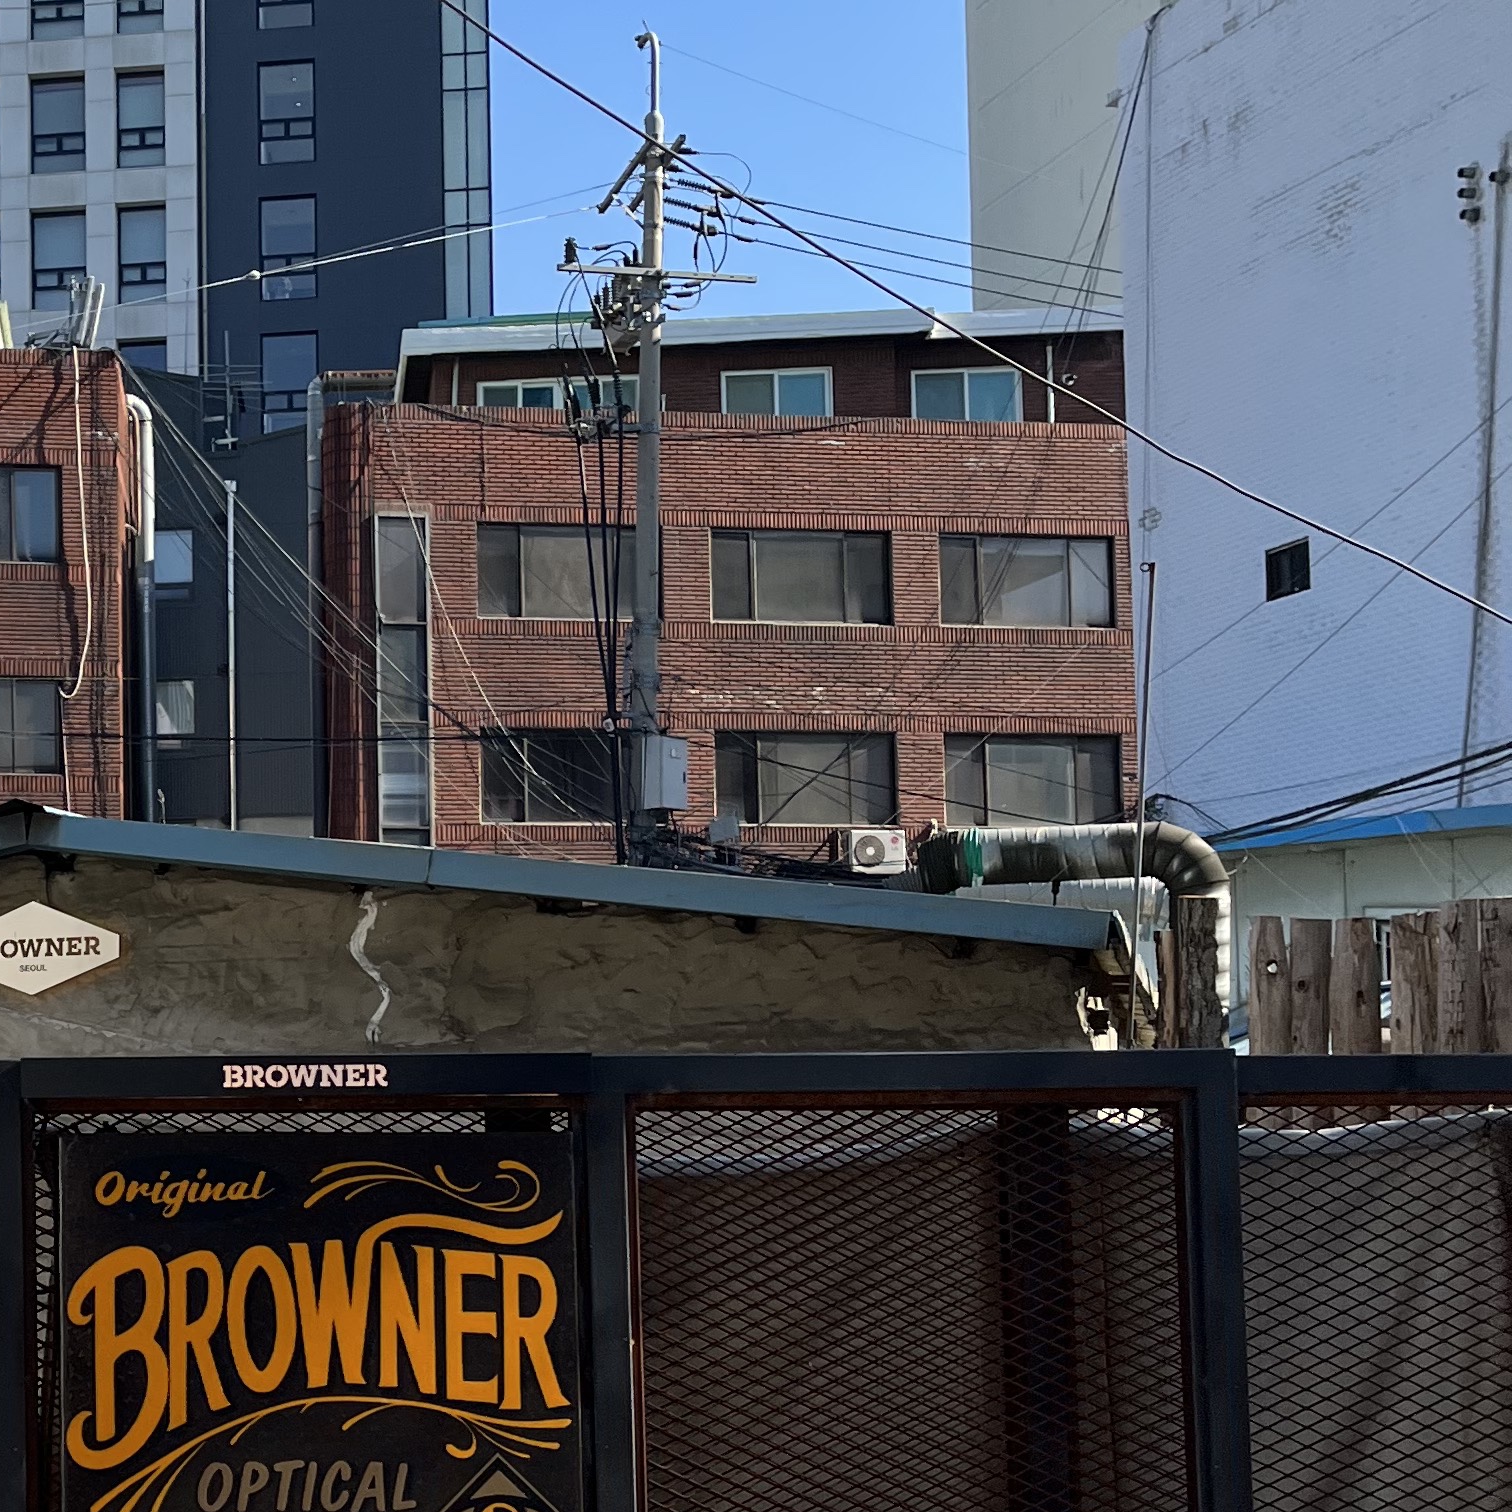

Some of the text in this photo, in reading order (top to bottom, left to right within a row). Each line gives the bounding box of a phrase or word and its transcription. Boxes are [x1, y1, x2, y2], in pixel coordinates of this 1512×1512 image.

[19, 964, 48, 973] SEOUL
[222, 1064, 388, 1088] BROWNER
[94, 1170, 275, 1218] Original
[66, 1212, 572, 1470] BROWNER
